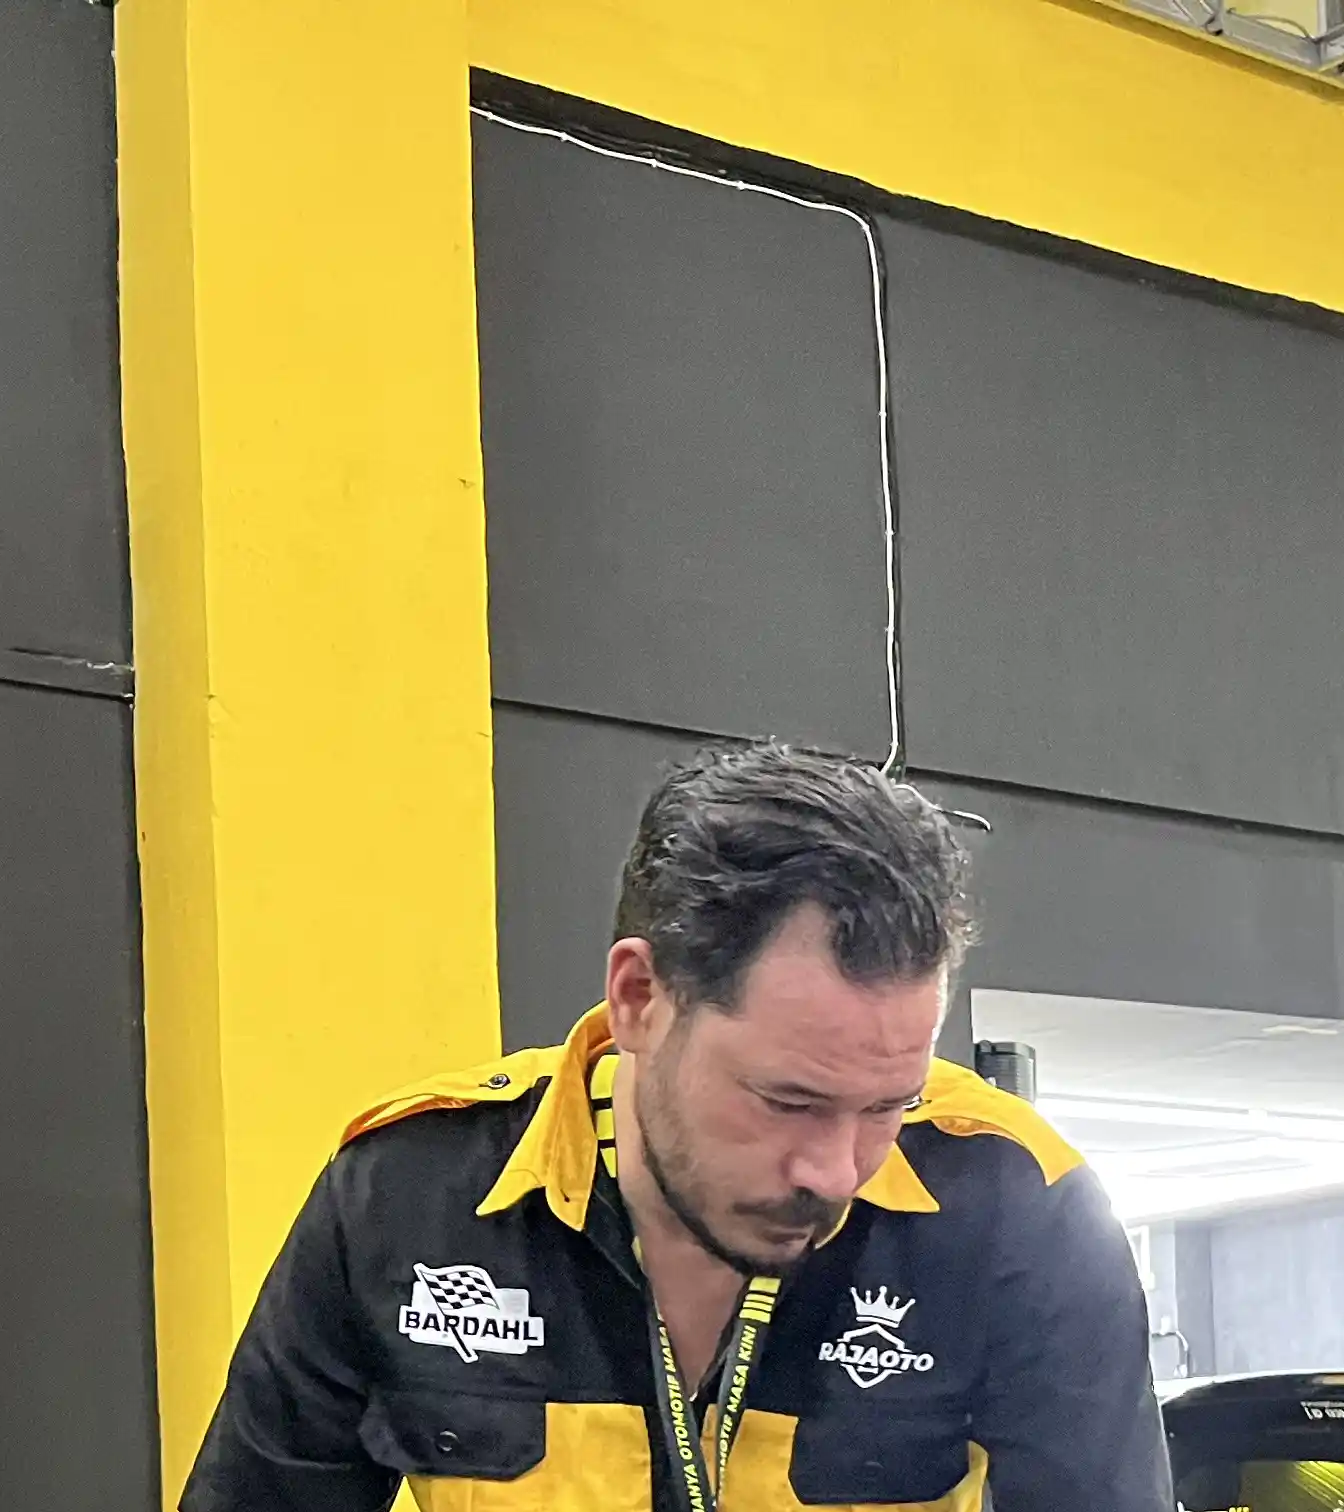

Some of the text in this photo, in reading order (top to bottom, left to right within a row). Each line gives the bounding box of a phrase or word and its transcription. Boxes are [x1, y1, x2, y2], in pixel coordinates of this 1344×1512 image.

[405, 1311, 538, 1341] BARDAHL
[726, 1365, 750, 1413] MASA
[738, 1324, 757, 1361] KINI
[818, 1342, 934, 1372] RAJAOTO
[666, 1374, 693, 1460] OTOMOTIF
